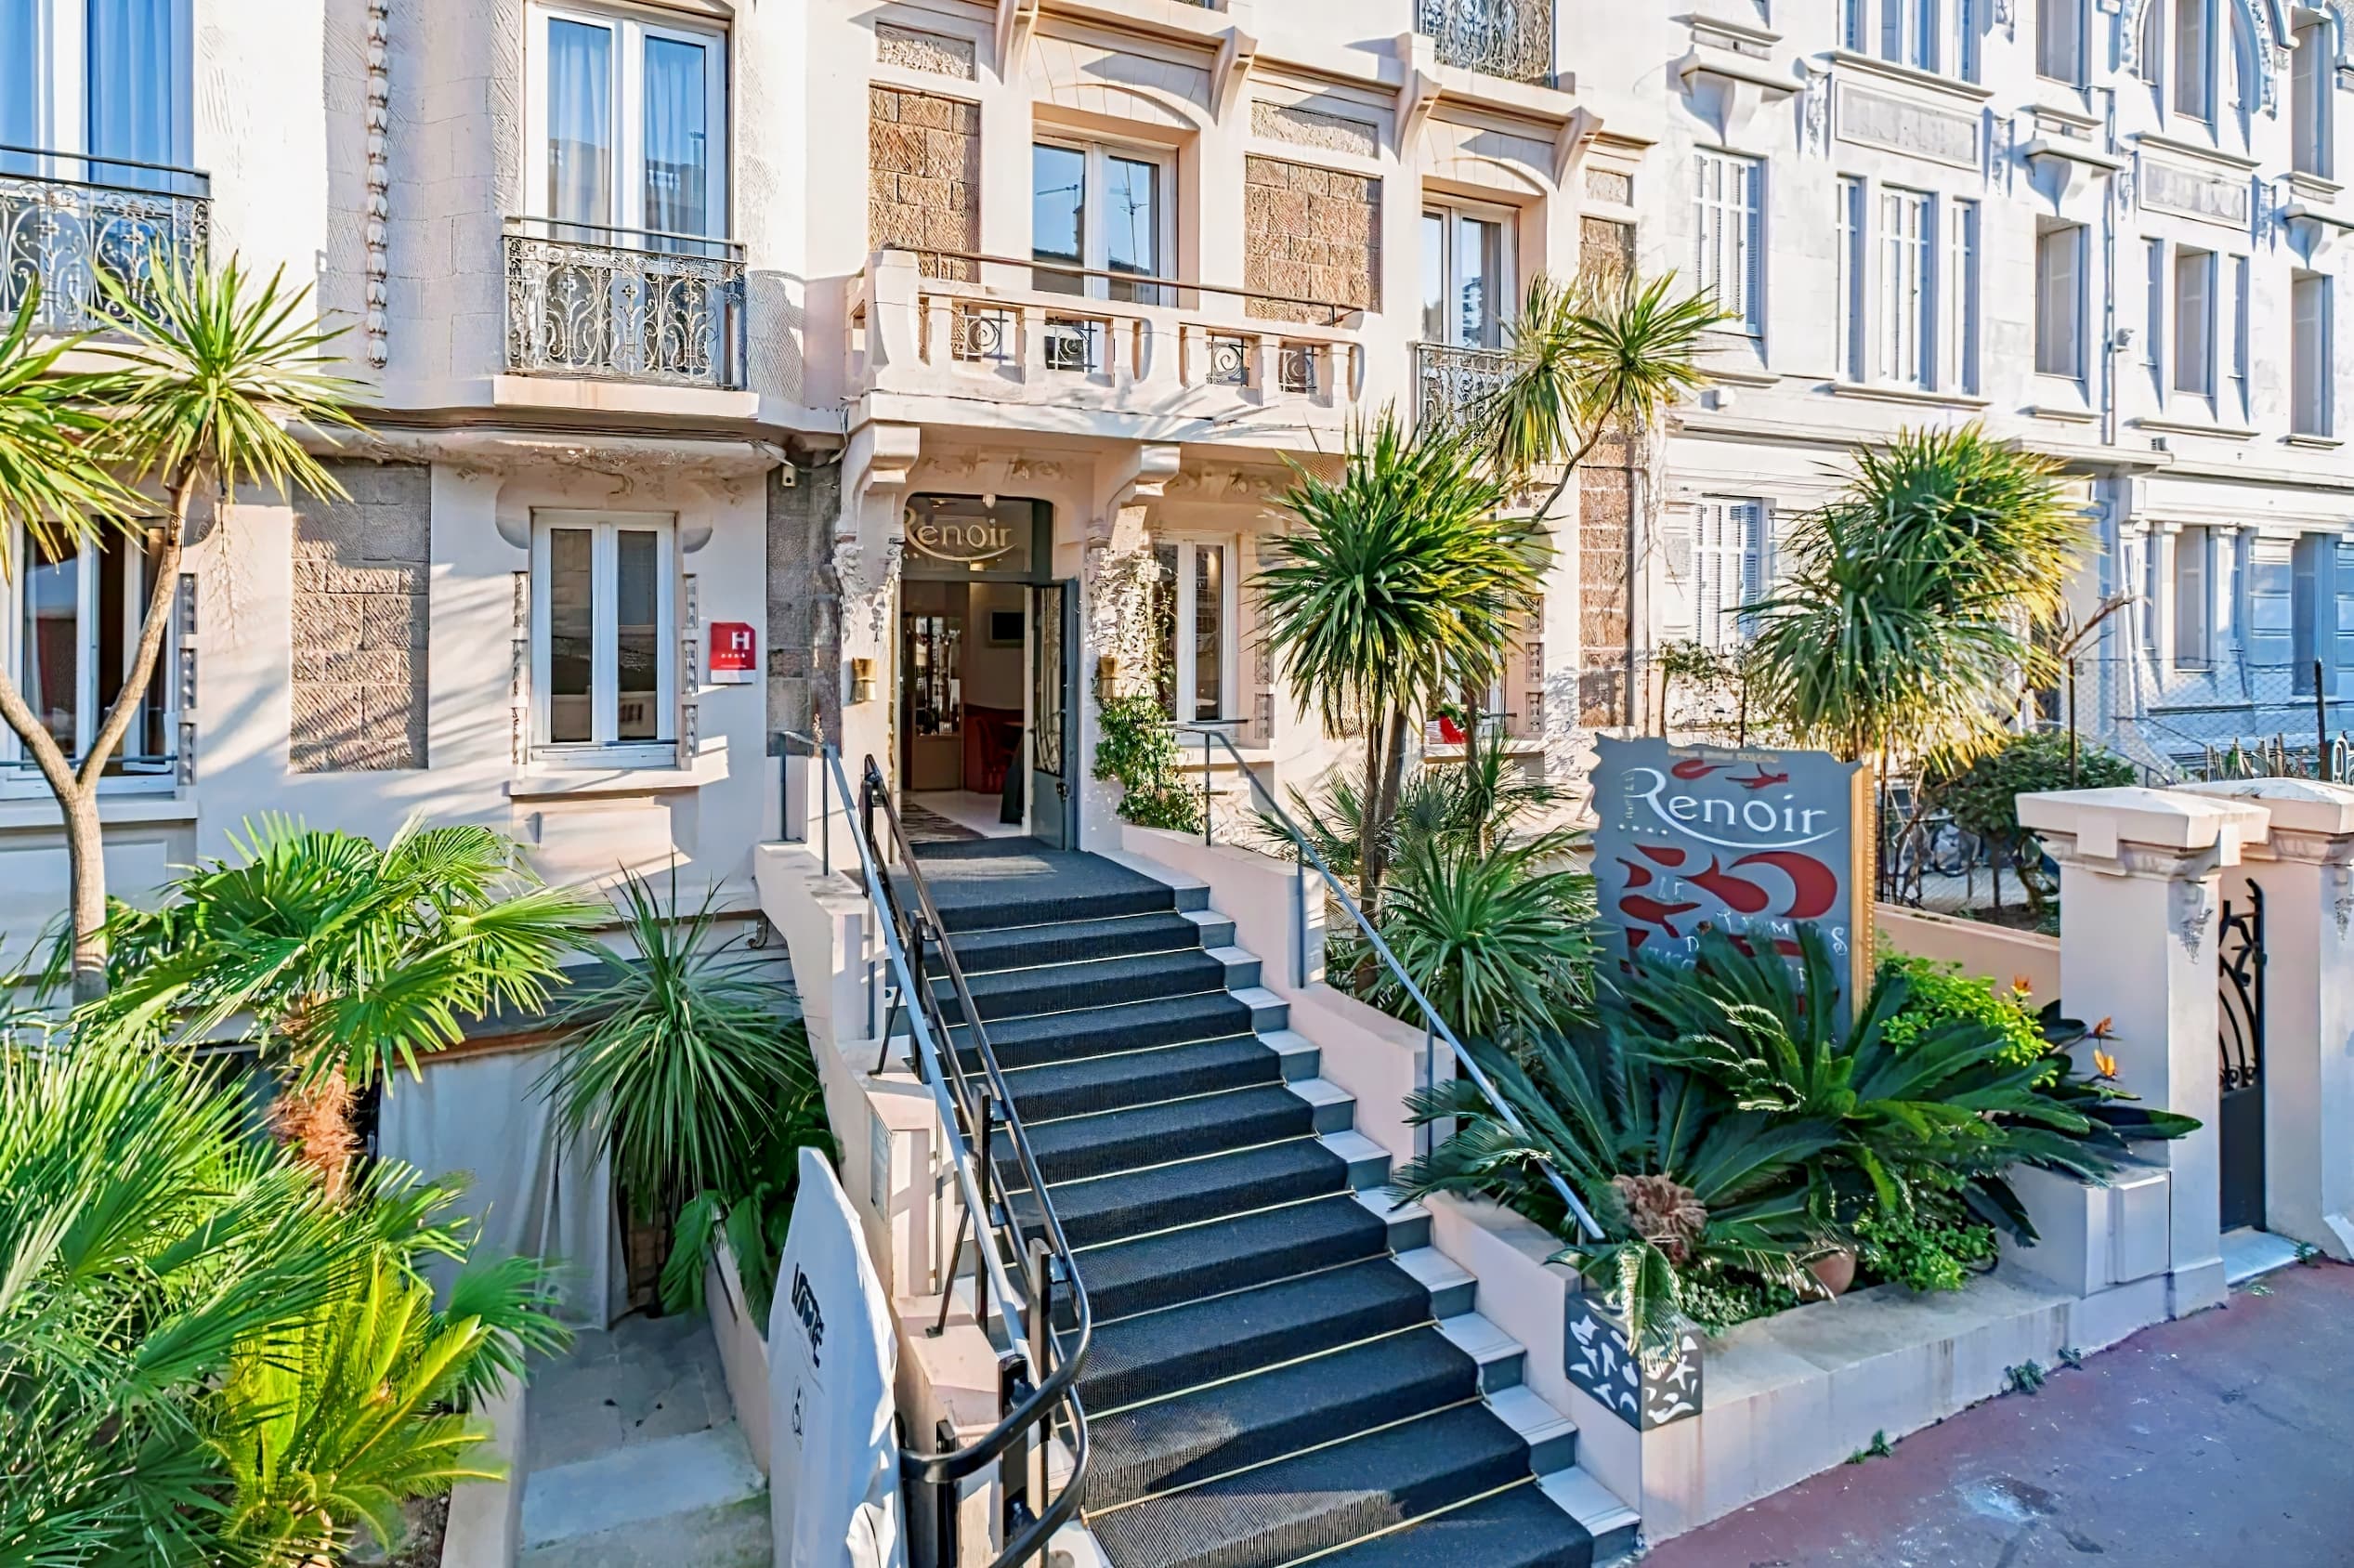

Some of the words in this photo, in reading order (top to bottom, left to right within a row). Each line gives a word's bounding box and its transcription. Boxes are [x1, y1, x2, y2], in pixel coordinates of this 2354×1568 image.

[904, 506, 1017, 562] Renoir
[731, 631, 751, 650] H
[1620, 767, 1840, 849] Renoir
